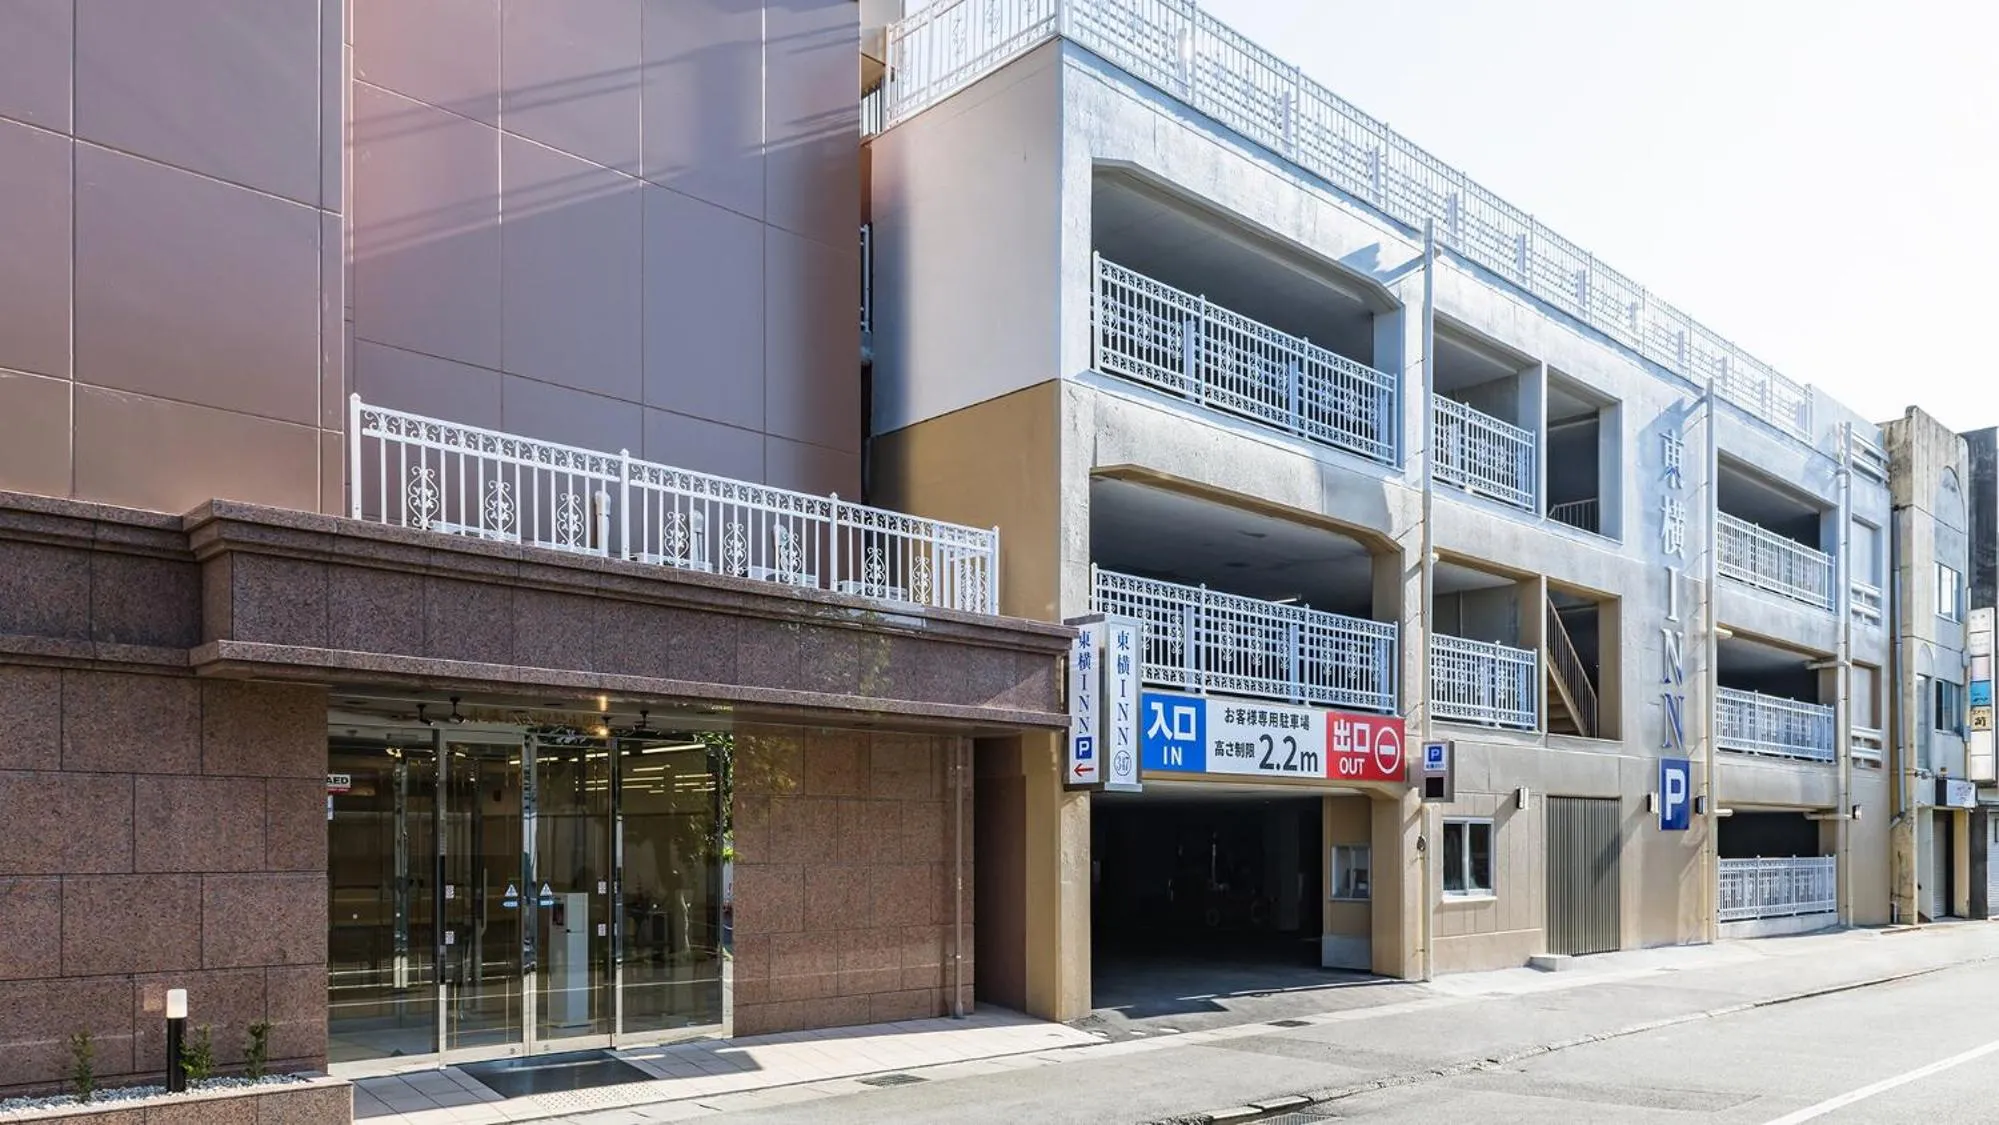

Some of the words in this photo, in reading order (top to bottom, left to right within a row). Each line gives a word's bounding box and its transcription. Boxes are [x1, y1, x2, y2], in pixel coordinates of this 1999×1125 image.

[1659, 429, 1685, 749] 東横INN
[1078, 631, 1092, 734] 東横INN
[1117, 630, 1130, 746] 東横INN
[1147, 701, 1197, 741] 入口
[1224, 708, 1310, 731] お客様専用駐車場
[1333, 719, 1370, 753] 出口
[1079, 741, 1090, 757] P
[1163, 746, 1183, 766] IN
[1214, 740, 1255, 758] 高さ制限
[1259, 734, 1318, 772] 2.2m
[1339, 756, 1365, 775] OUT
[1665, 768, 1685, 820] P
